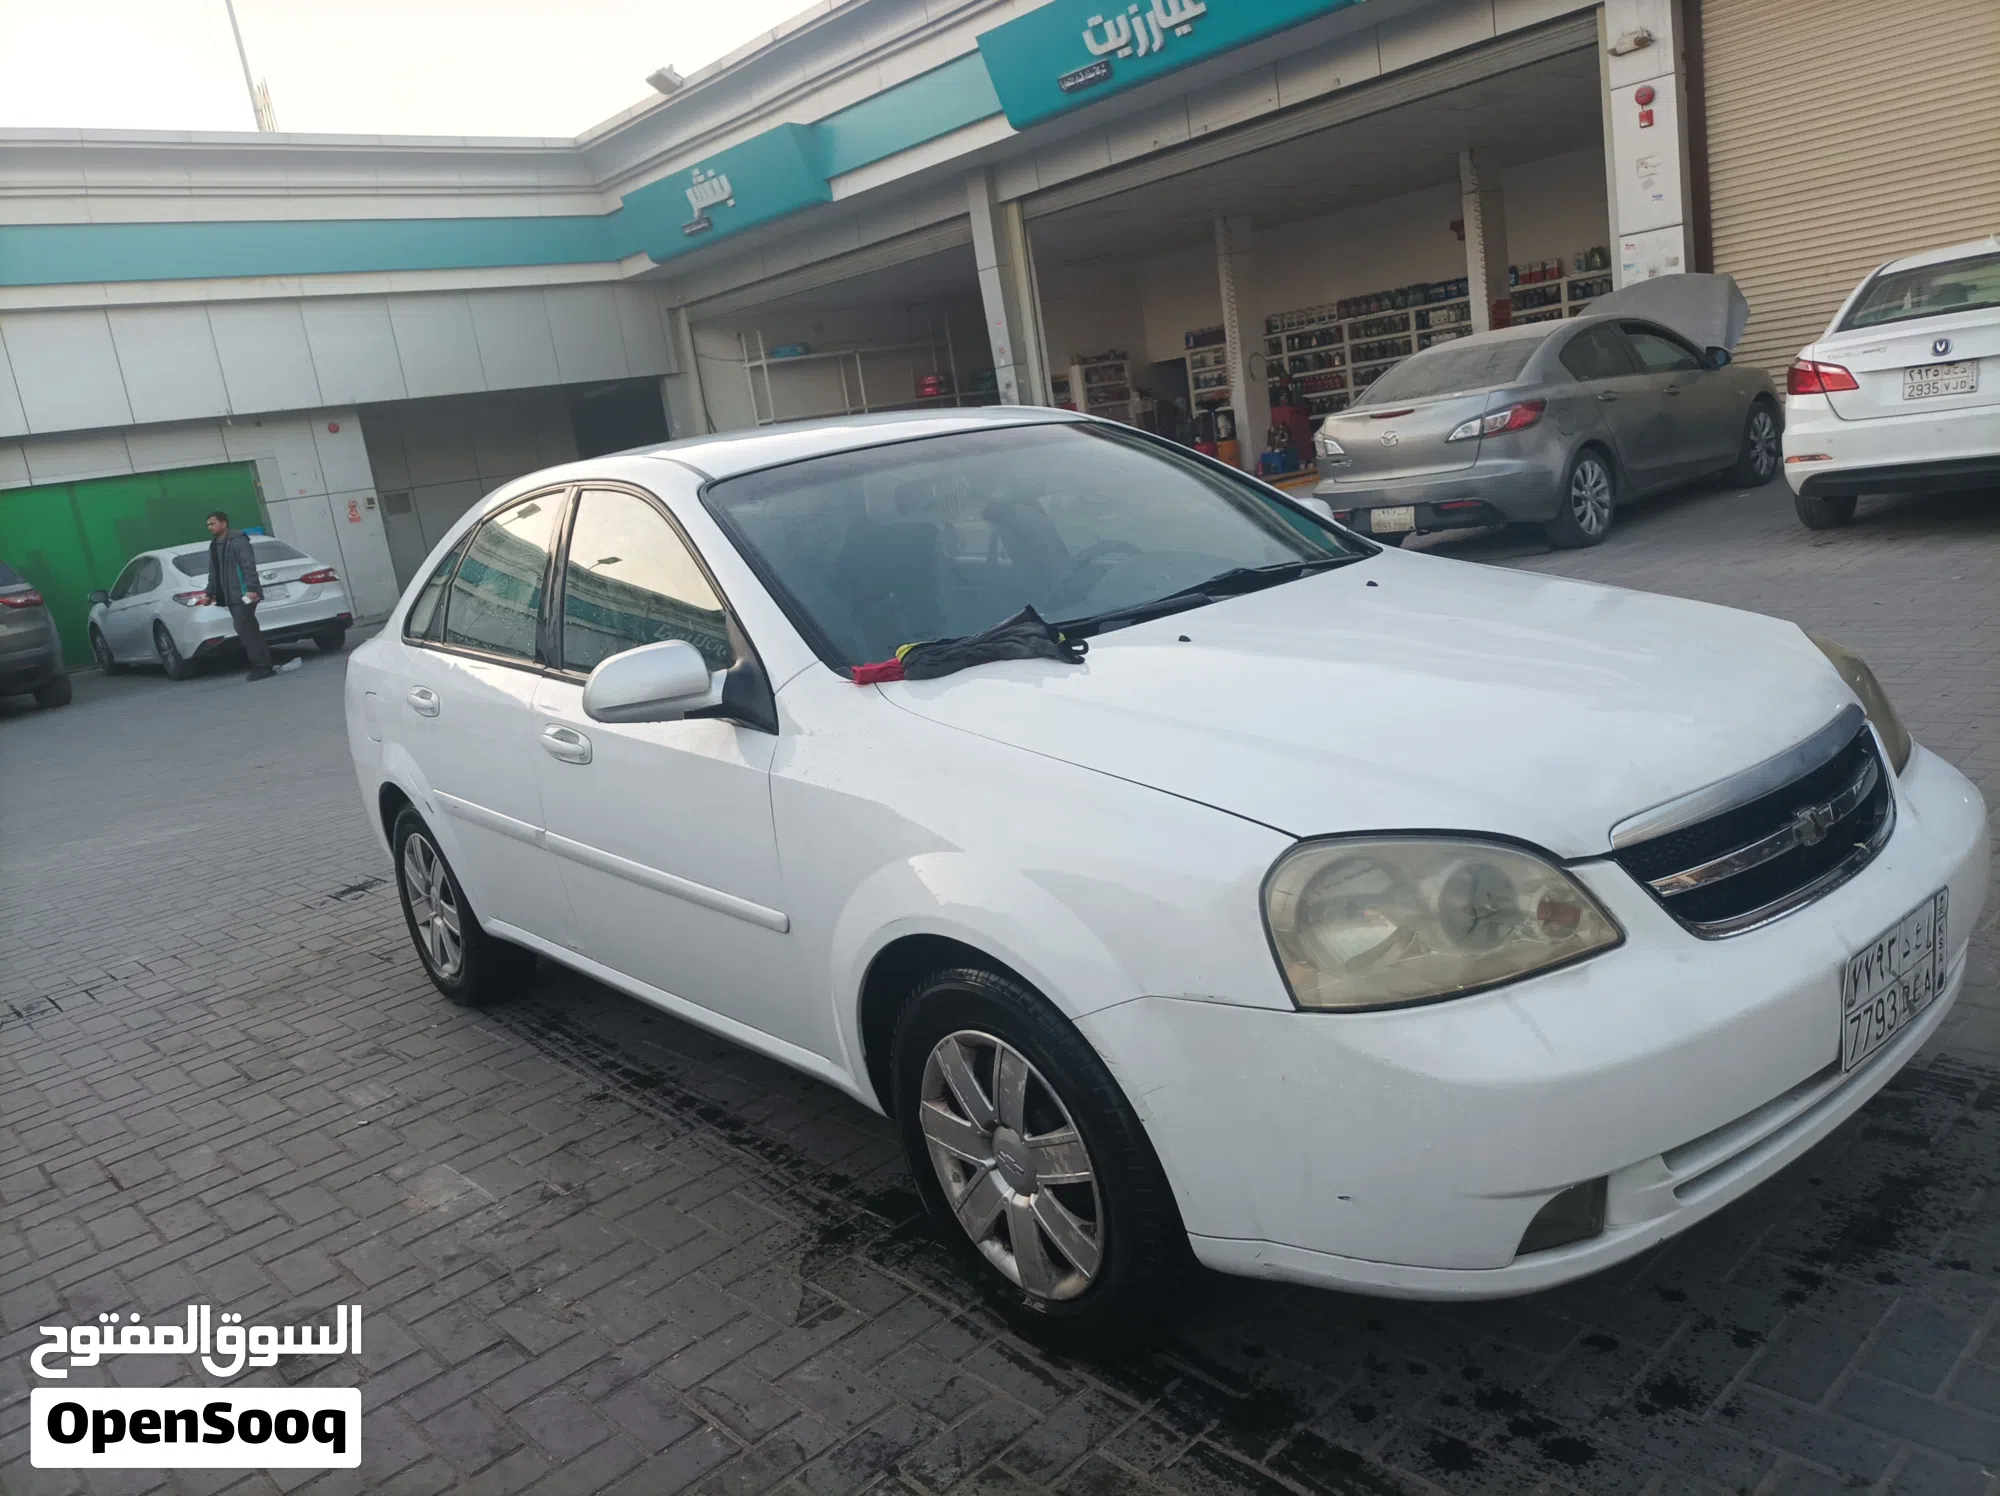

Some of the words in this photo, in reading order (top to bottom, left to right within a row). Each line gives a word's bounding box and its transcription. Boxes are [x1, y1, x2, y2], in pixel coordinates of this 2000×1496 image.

[1082, 3, 1148, 58] زيت
[1907, 381, 1940, 398] 2935
[1849, 988, 1897, 1061] 7793
